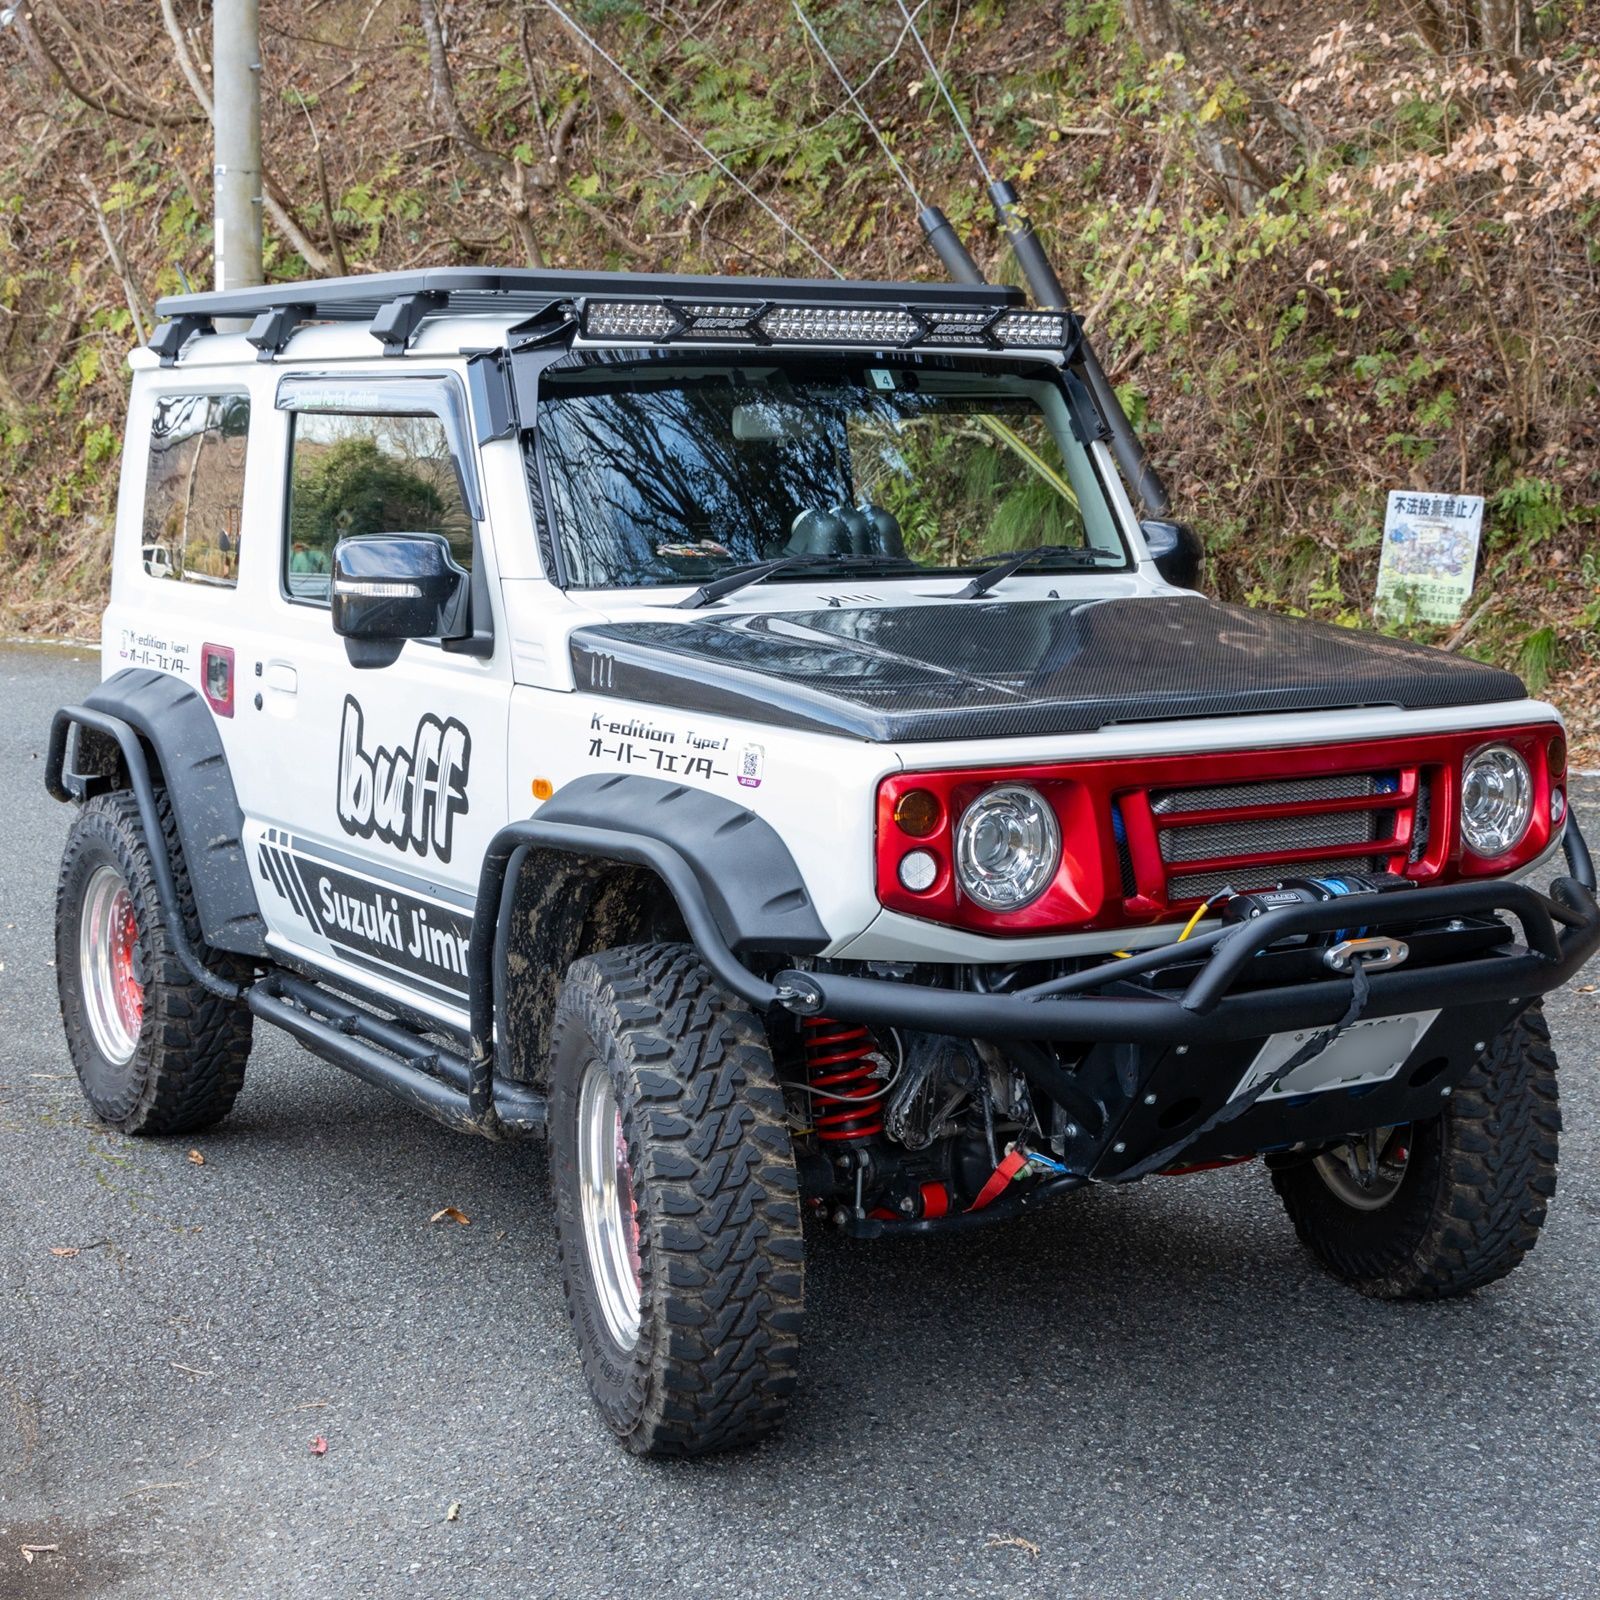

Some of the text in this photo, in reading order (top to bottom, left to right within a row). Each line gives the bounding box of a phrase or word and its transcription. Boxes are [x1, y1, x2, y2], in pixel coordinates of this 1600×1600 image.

[883, 376, 890, 386] 4
[130, 630, 167, 650] K-edition
[590, 712, 675, 745] K-edition
[337, 693, 471, 863] buff
[318, 876, 471, 977] Suzuki Jimn
